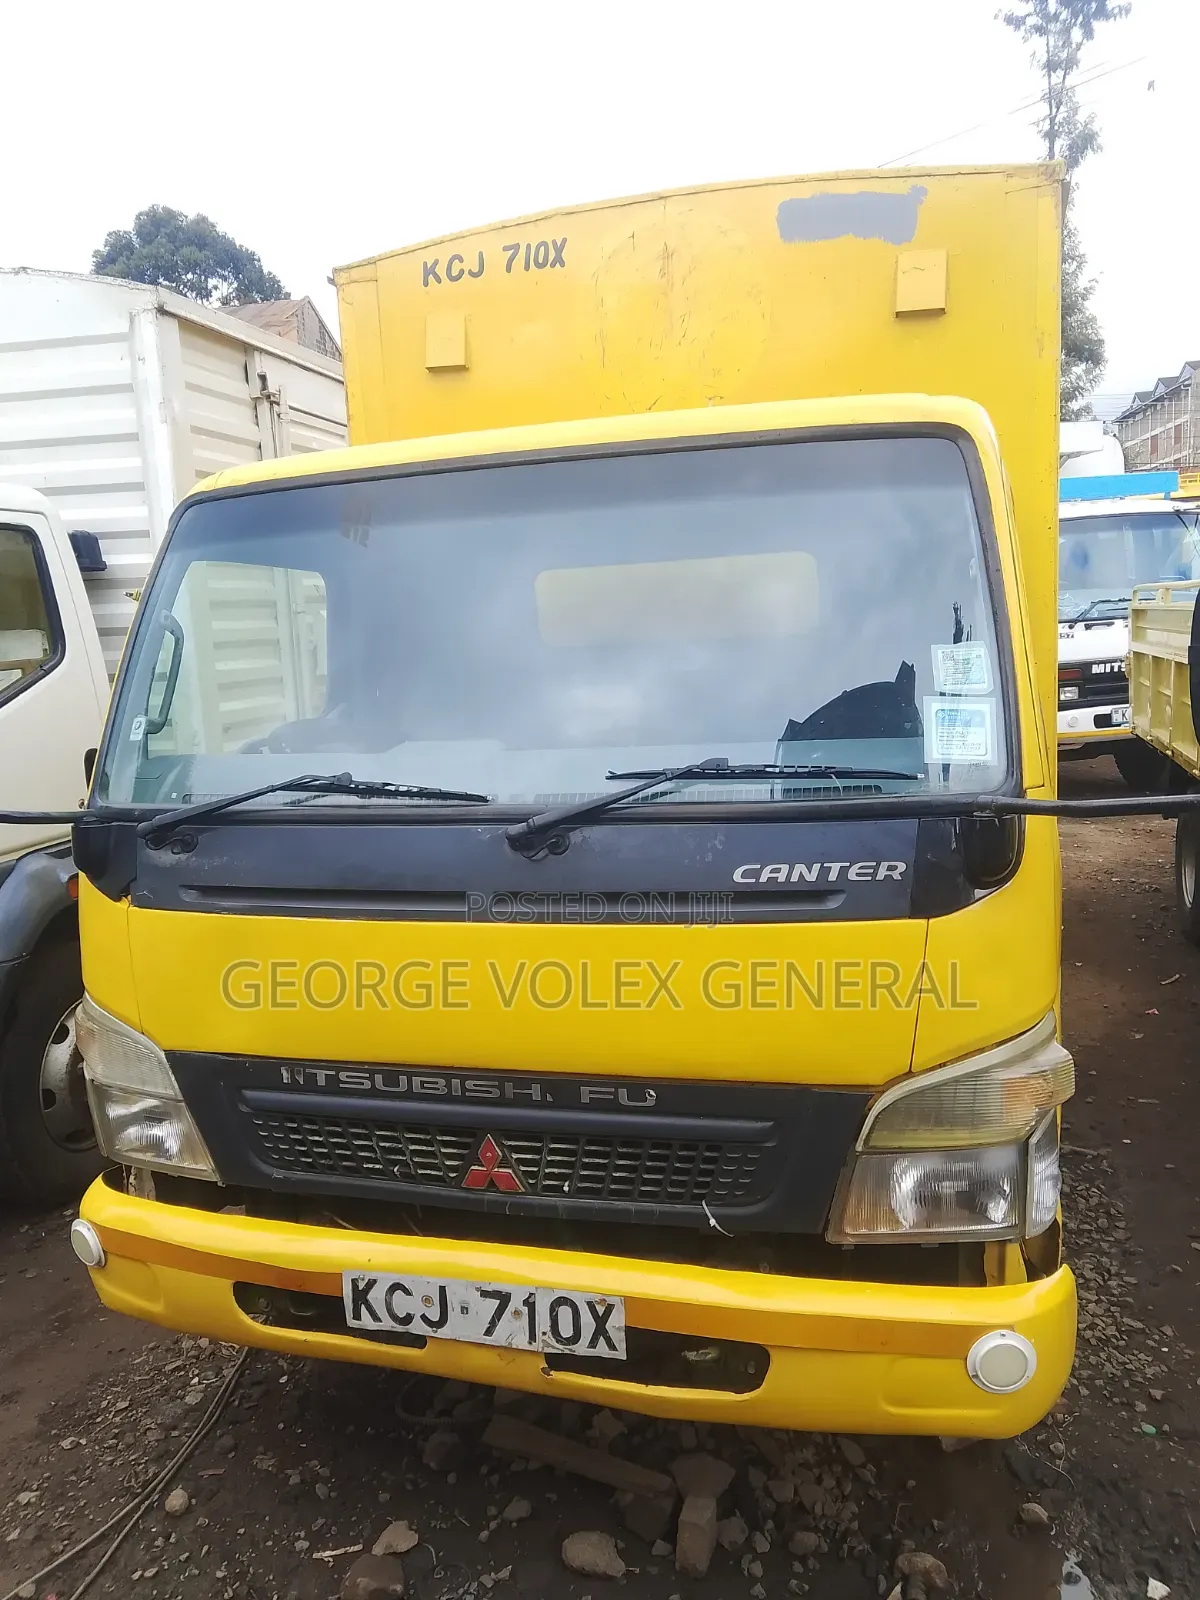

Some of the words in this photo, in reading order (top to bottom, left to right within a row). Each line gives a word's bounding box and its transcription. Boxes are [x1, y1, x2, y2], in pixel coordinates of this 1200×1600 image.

[422, 250, 485, 287] KCJ
[502, 237, 567, 273] 710X
[732, 861, 907, 883] CANTER
[350, 1277, 449, 1331] KCJ
[479, 1289, 619, 1352] 710X
